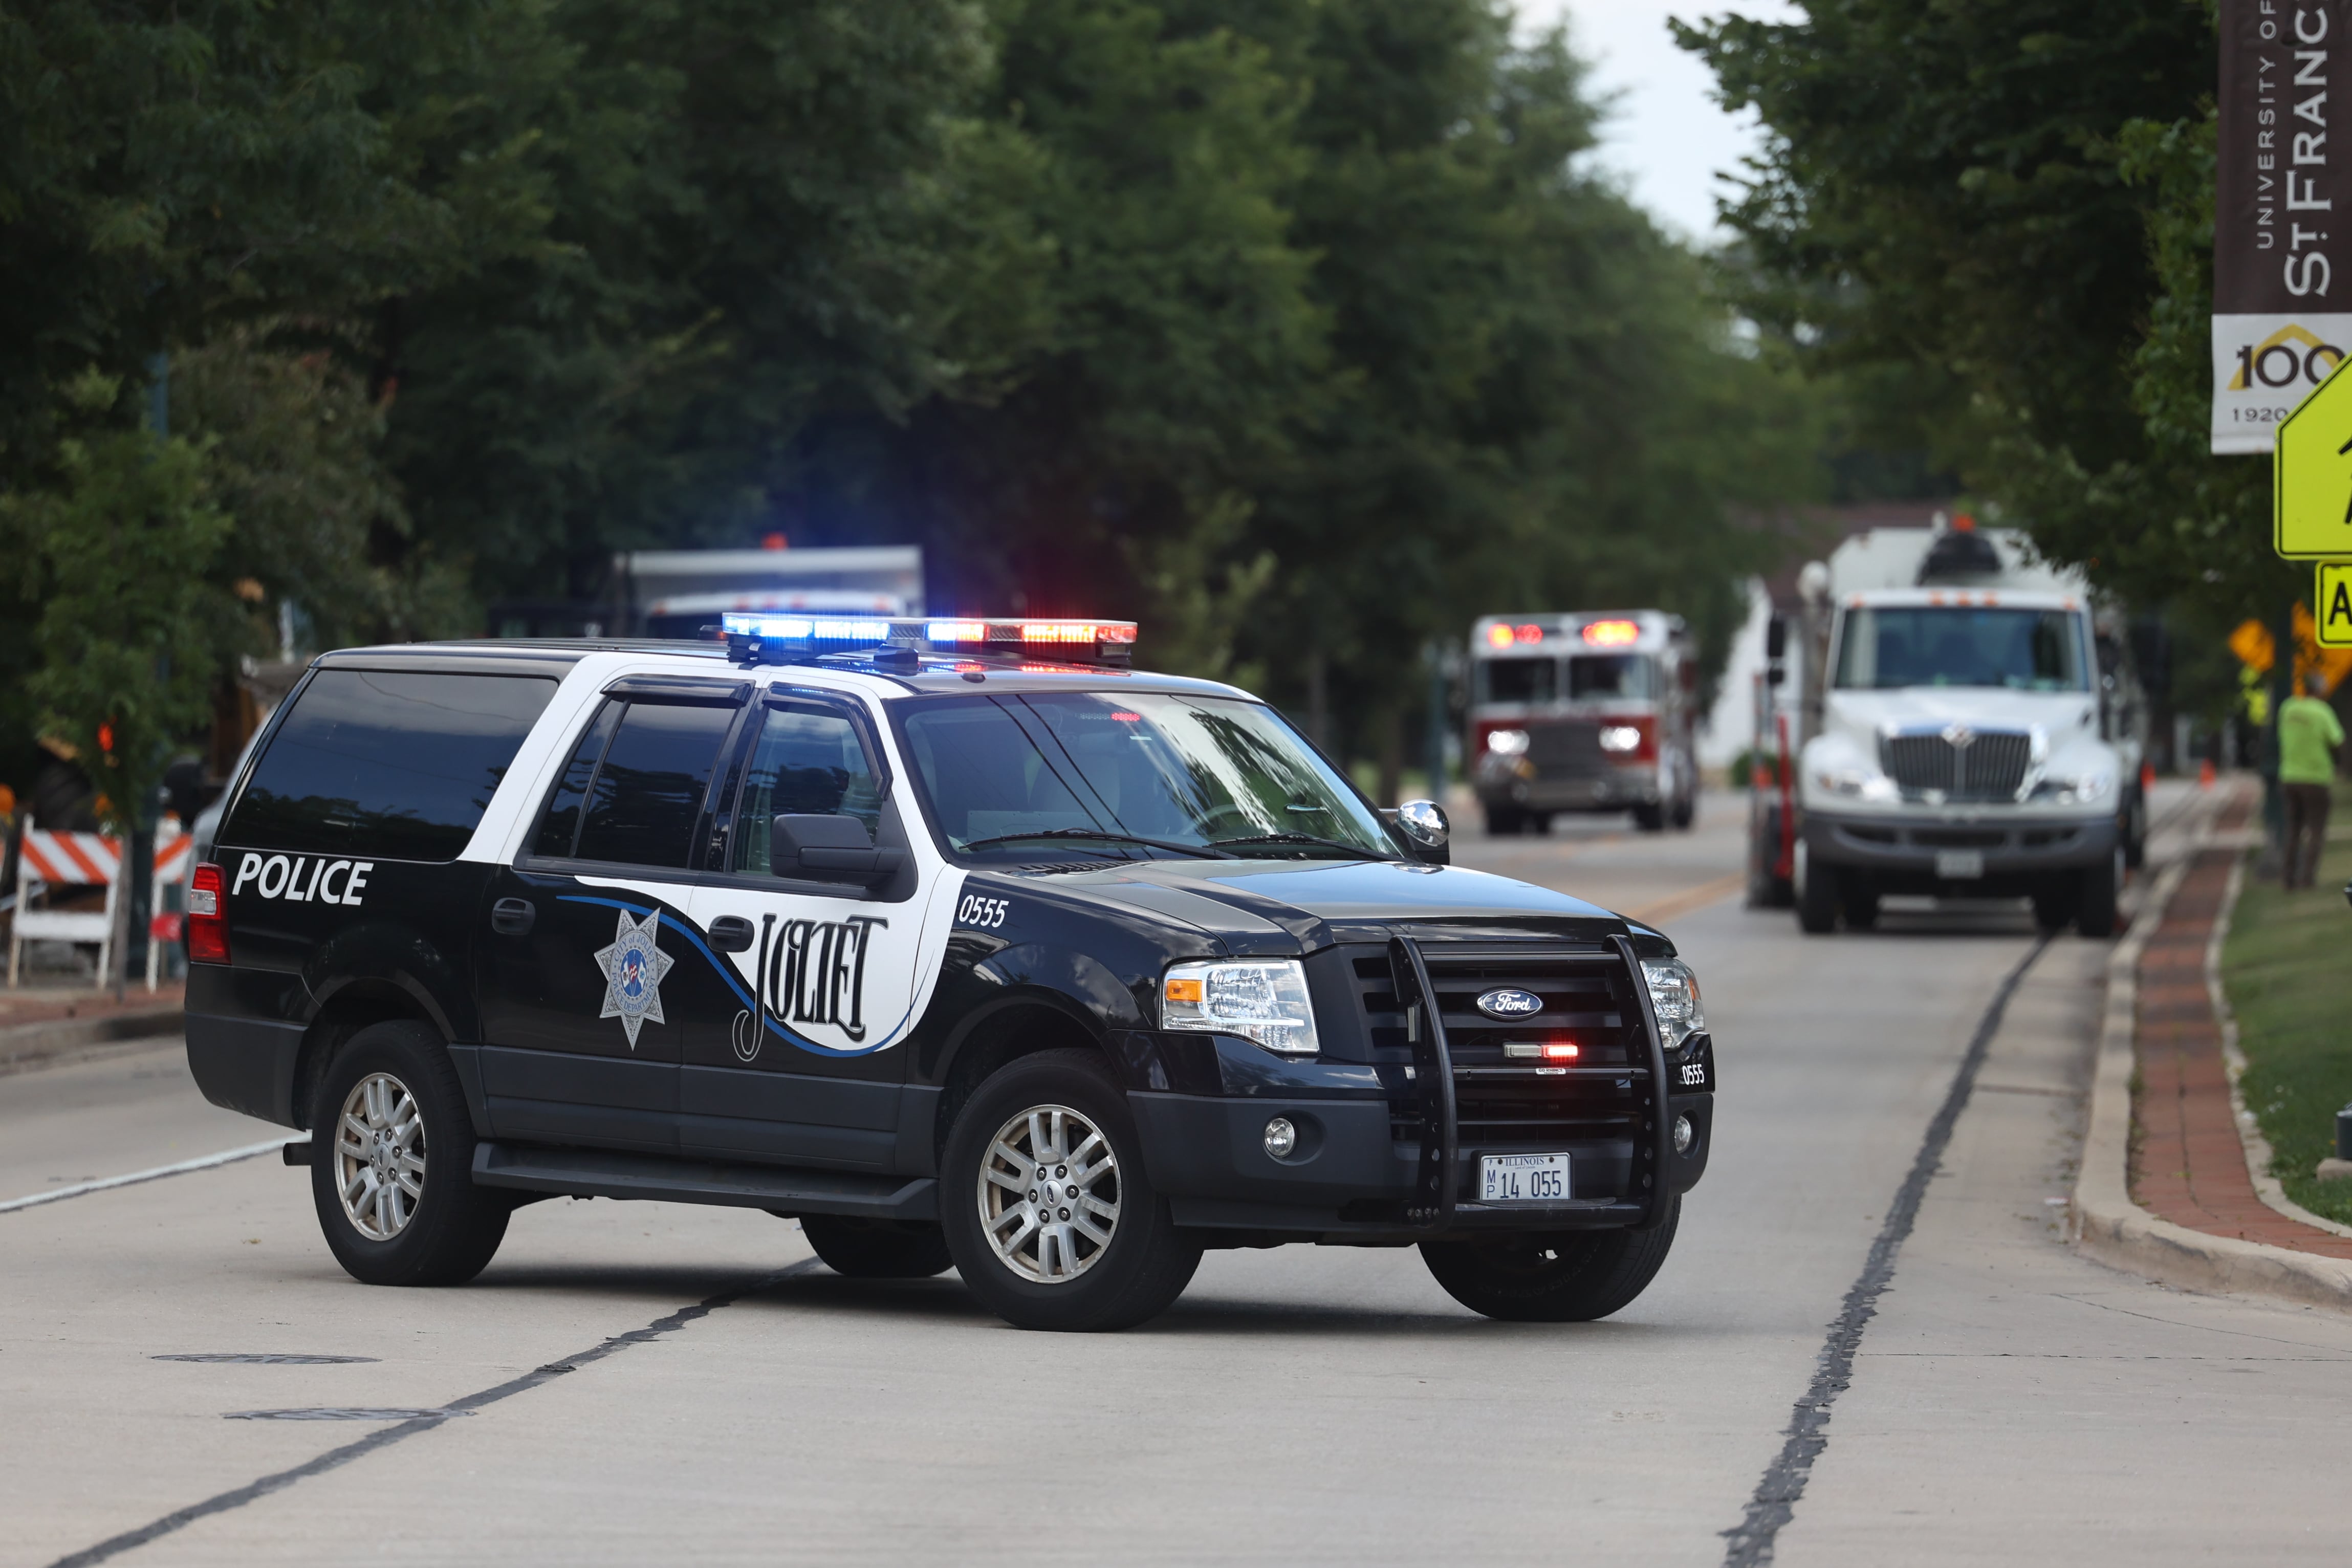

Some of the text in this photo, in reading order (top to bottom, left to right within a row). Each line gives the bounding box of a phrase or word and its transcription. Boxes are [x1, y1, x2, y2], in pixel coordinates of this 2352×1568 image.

[2285, 0, 2332, 211] FRANC
[2256, 0, 2277, 249] UNIVERSITY OF
[2233, 407, 2288, 422] 1920
[232, 853, 374, 906] POLICE
[959, 894, 1010, 928] 0555
[614, 934, 655, 964] CITY of JOLIET
[612, 972, 656, 1012] POLICE DEPARTMENT
[732, 912, 889, 1062] JOLIET
[1495, 993, 1531, 1011] Ford
[1682, 1063, 1705, 1085] 0555
[1505, 1157, 1544, 1166] ILLINOIS
[1500, 1170, 1561, 1199] 14 055
